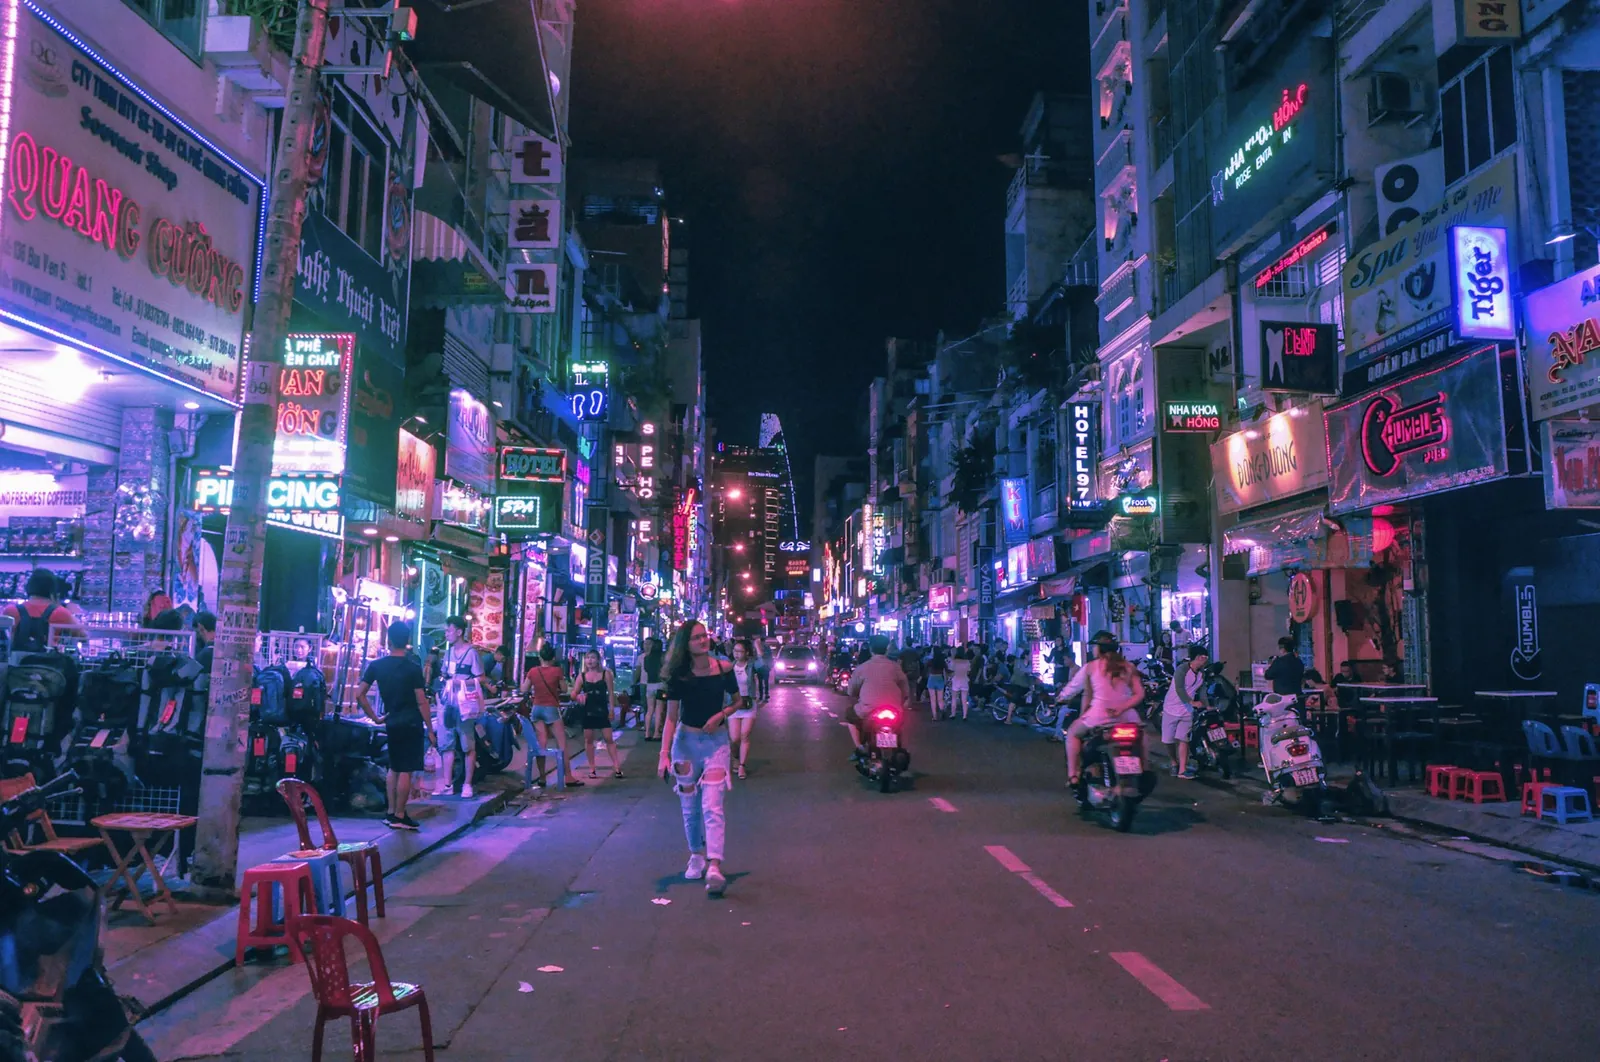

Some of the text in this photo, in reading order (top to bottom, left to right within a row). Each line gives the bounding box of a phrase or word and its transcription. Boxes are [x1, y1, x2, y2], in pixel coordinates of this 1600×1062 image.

[7, 131, 142, 259] QUANG
[1467, 246, 1504, 321] Tiger
[280, 369, 341, 396] ANG
[1169, 405, 1218, 415] NHA KHOA
[506, 454, 561, 475] HOTEL
[501, 500, 534, 513] SPA
[588, 546, 604, 585] BIDV
[981, 577, 994, 604] BIDV
